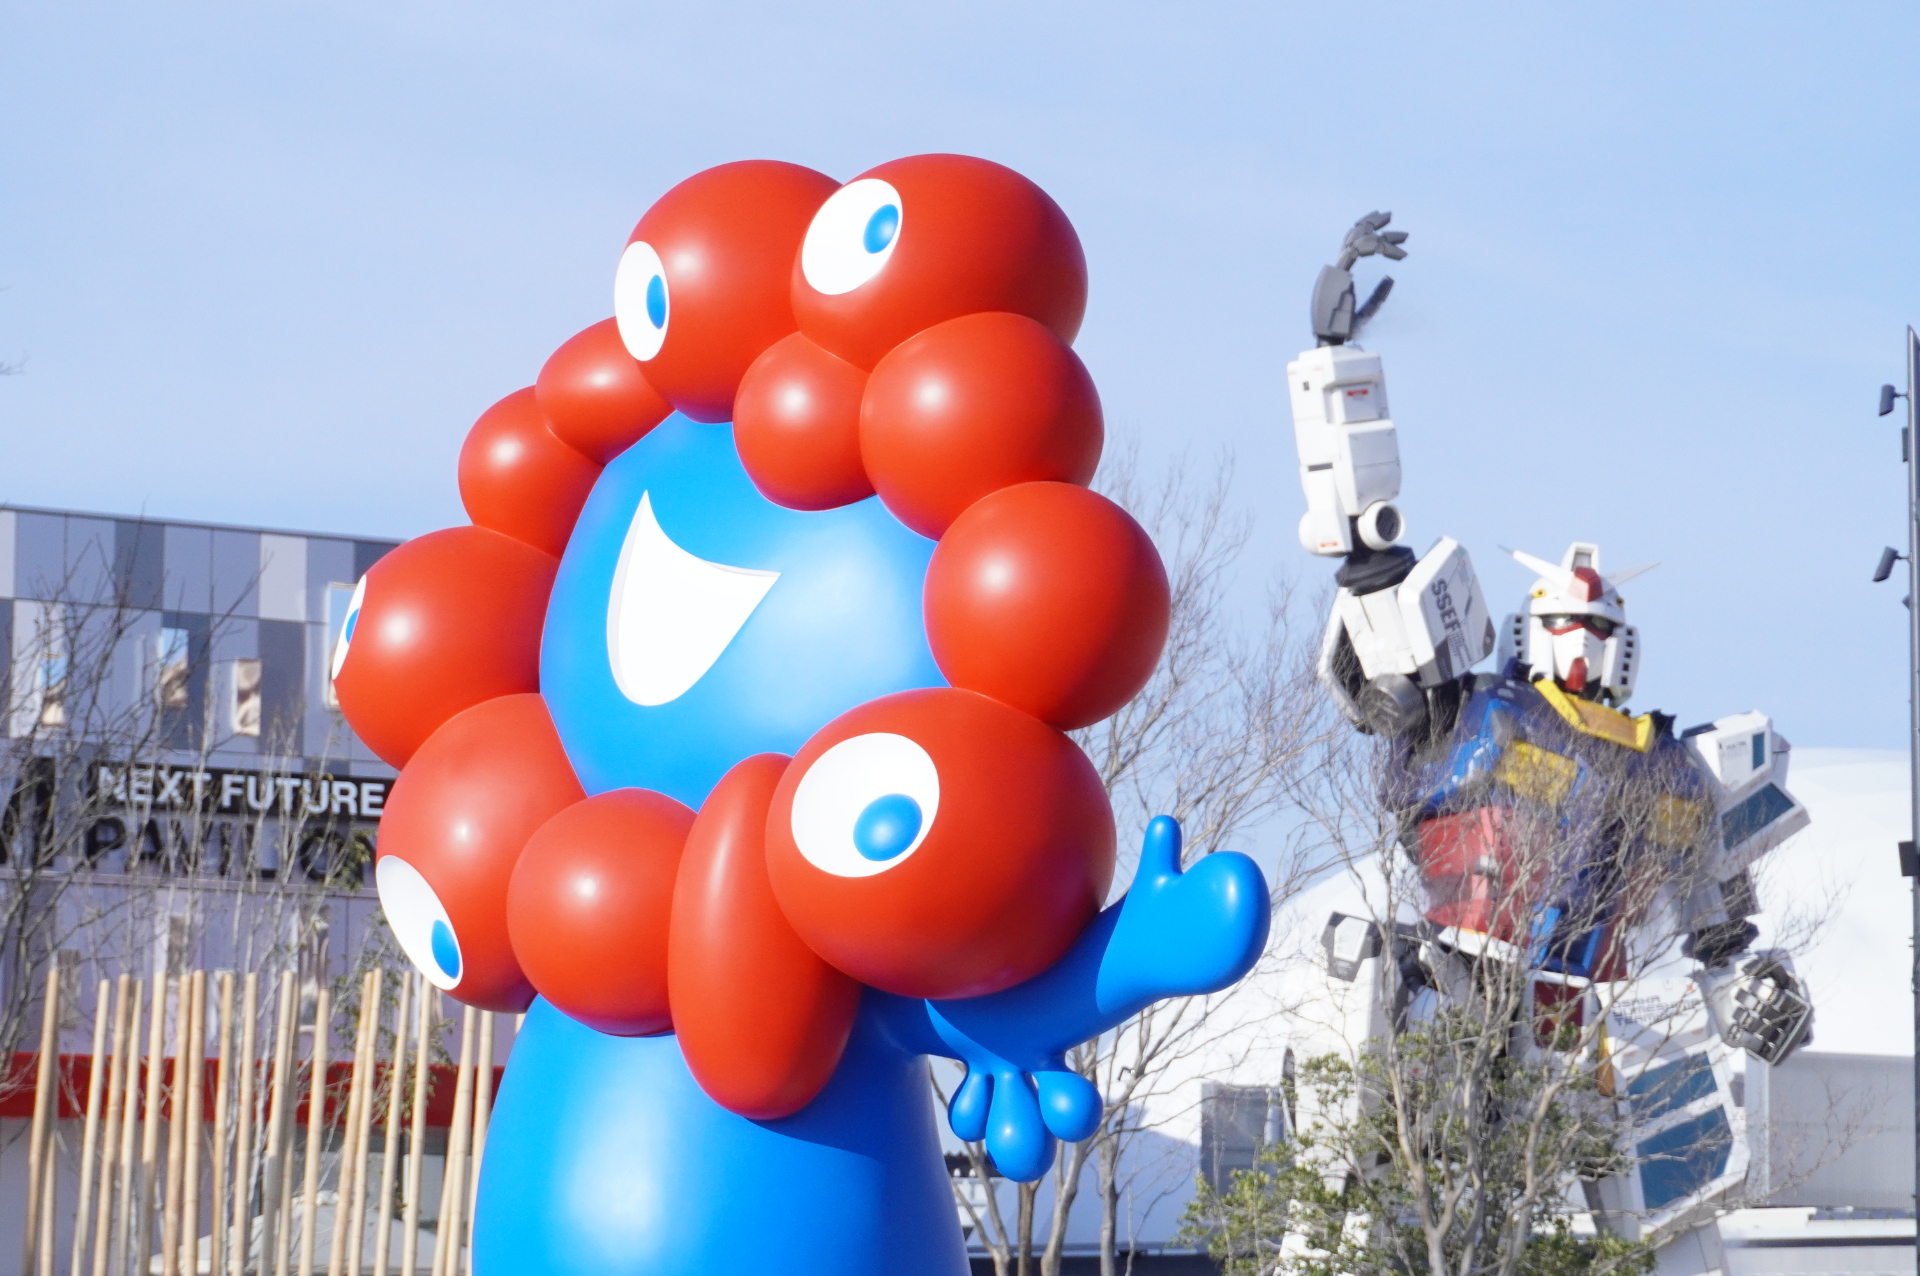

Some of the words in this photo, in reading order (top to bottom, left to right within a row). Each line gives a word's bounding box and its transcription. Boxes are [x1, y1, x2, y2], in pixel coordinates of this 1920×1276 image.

[1431, 577, 1462, 631] SSEF
[98, 765, 212, 805] NEXT
[221, 773, 386, 817] FUTURE
[85, 815, 379, 884] PAVILO
